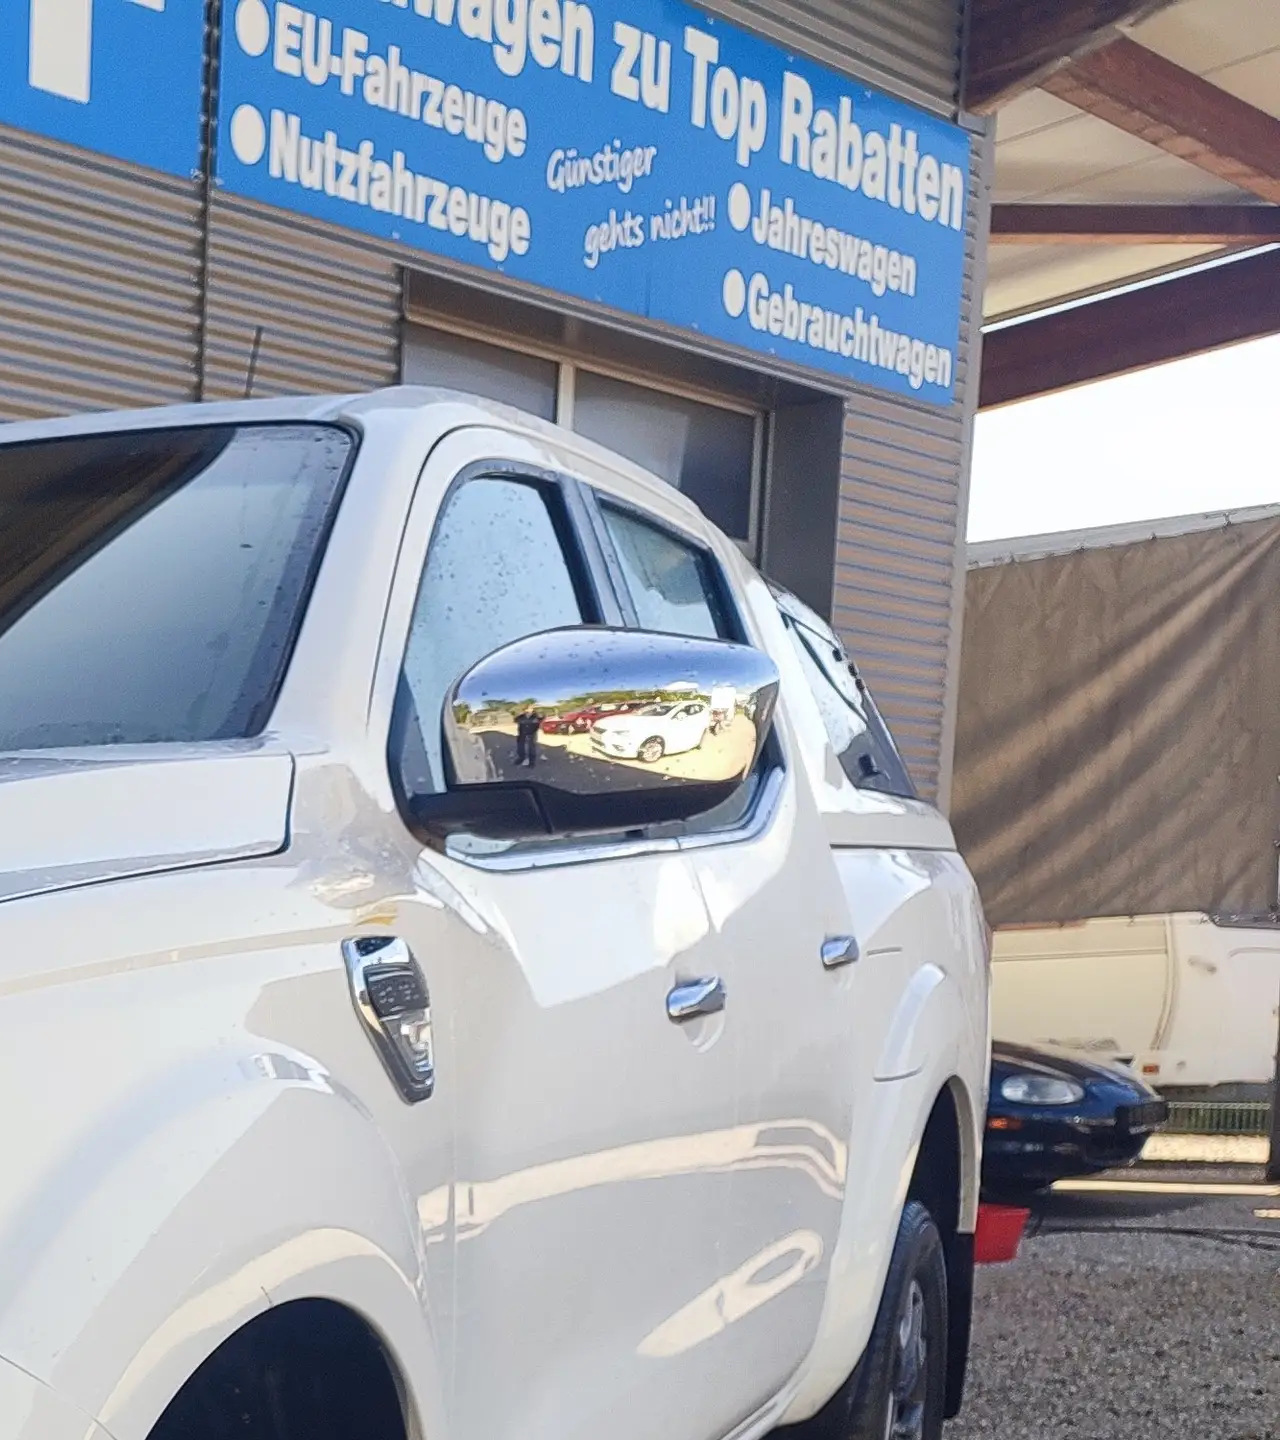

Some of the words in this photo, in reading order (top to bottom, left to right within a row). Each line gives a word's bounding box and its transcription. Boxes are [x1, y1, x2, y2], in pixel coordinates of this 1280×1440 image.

[273, 1, 528, 163] EU-Fahrzeuge
[610, 21, 671, 113] zu
[684, 26, 767, 167] Top
[779, 71, 965, 231] Rabatten
[268, 108, 532, 262] Nutzfahrzeuge
[546, 138, 658, 194] Günstiger
[584, 208, 644, 269] gehts
[650, 194, 716, 242] nicht!!
[751, 189, 917, 297] Jahreswagen
[747, 271, 952, 389] Gebrauchtwagen
